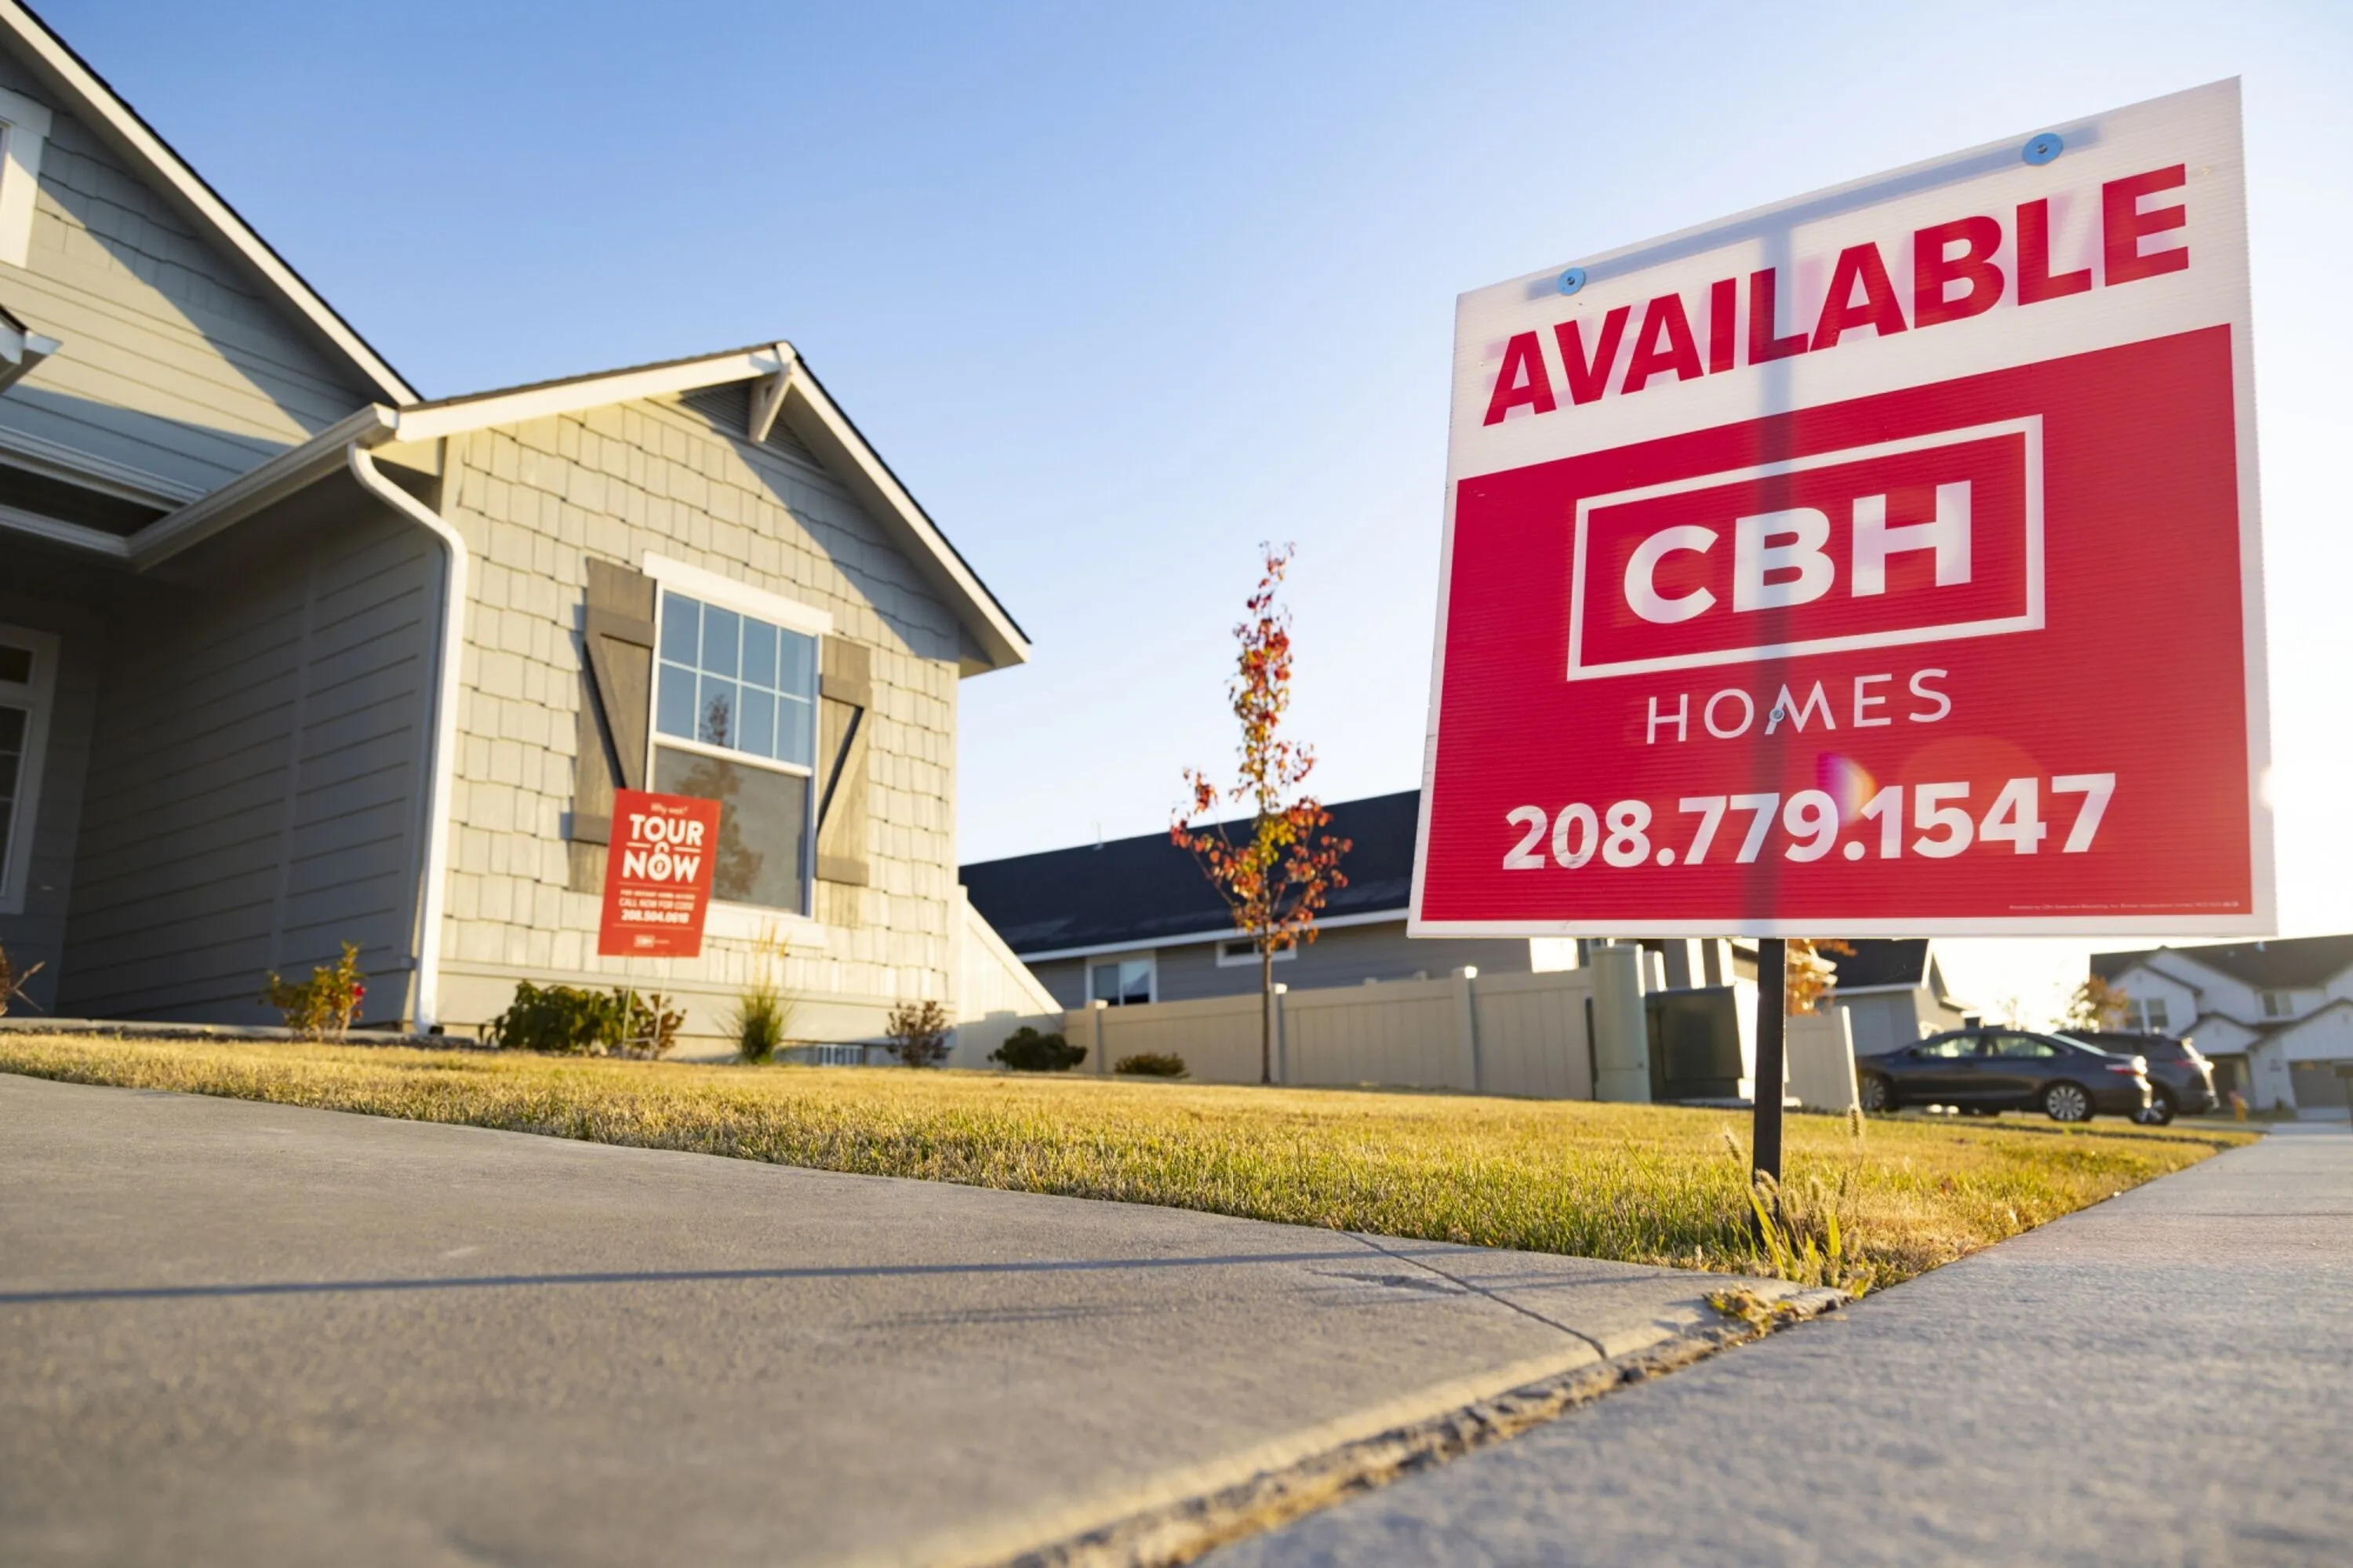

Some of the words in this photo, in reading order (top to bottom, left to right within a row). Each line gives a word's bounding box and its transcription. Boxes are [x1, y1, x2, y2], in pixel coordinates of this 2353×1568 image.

[1483, 164, 2188, 427] AVAILABLE
[1624, 480, 1972, 624] CBH
[1646, 668, 1951, 744] HOMES
[629, 813, 704, 846] TOUR
[1503, 772, 2117, 870] 208.779.1547
[622, 848, 700, 883] NOW
